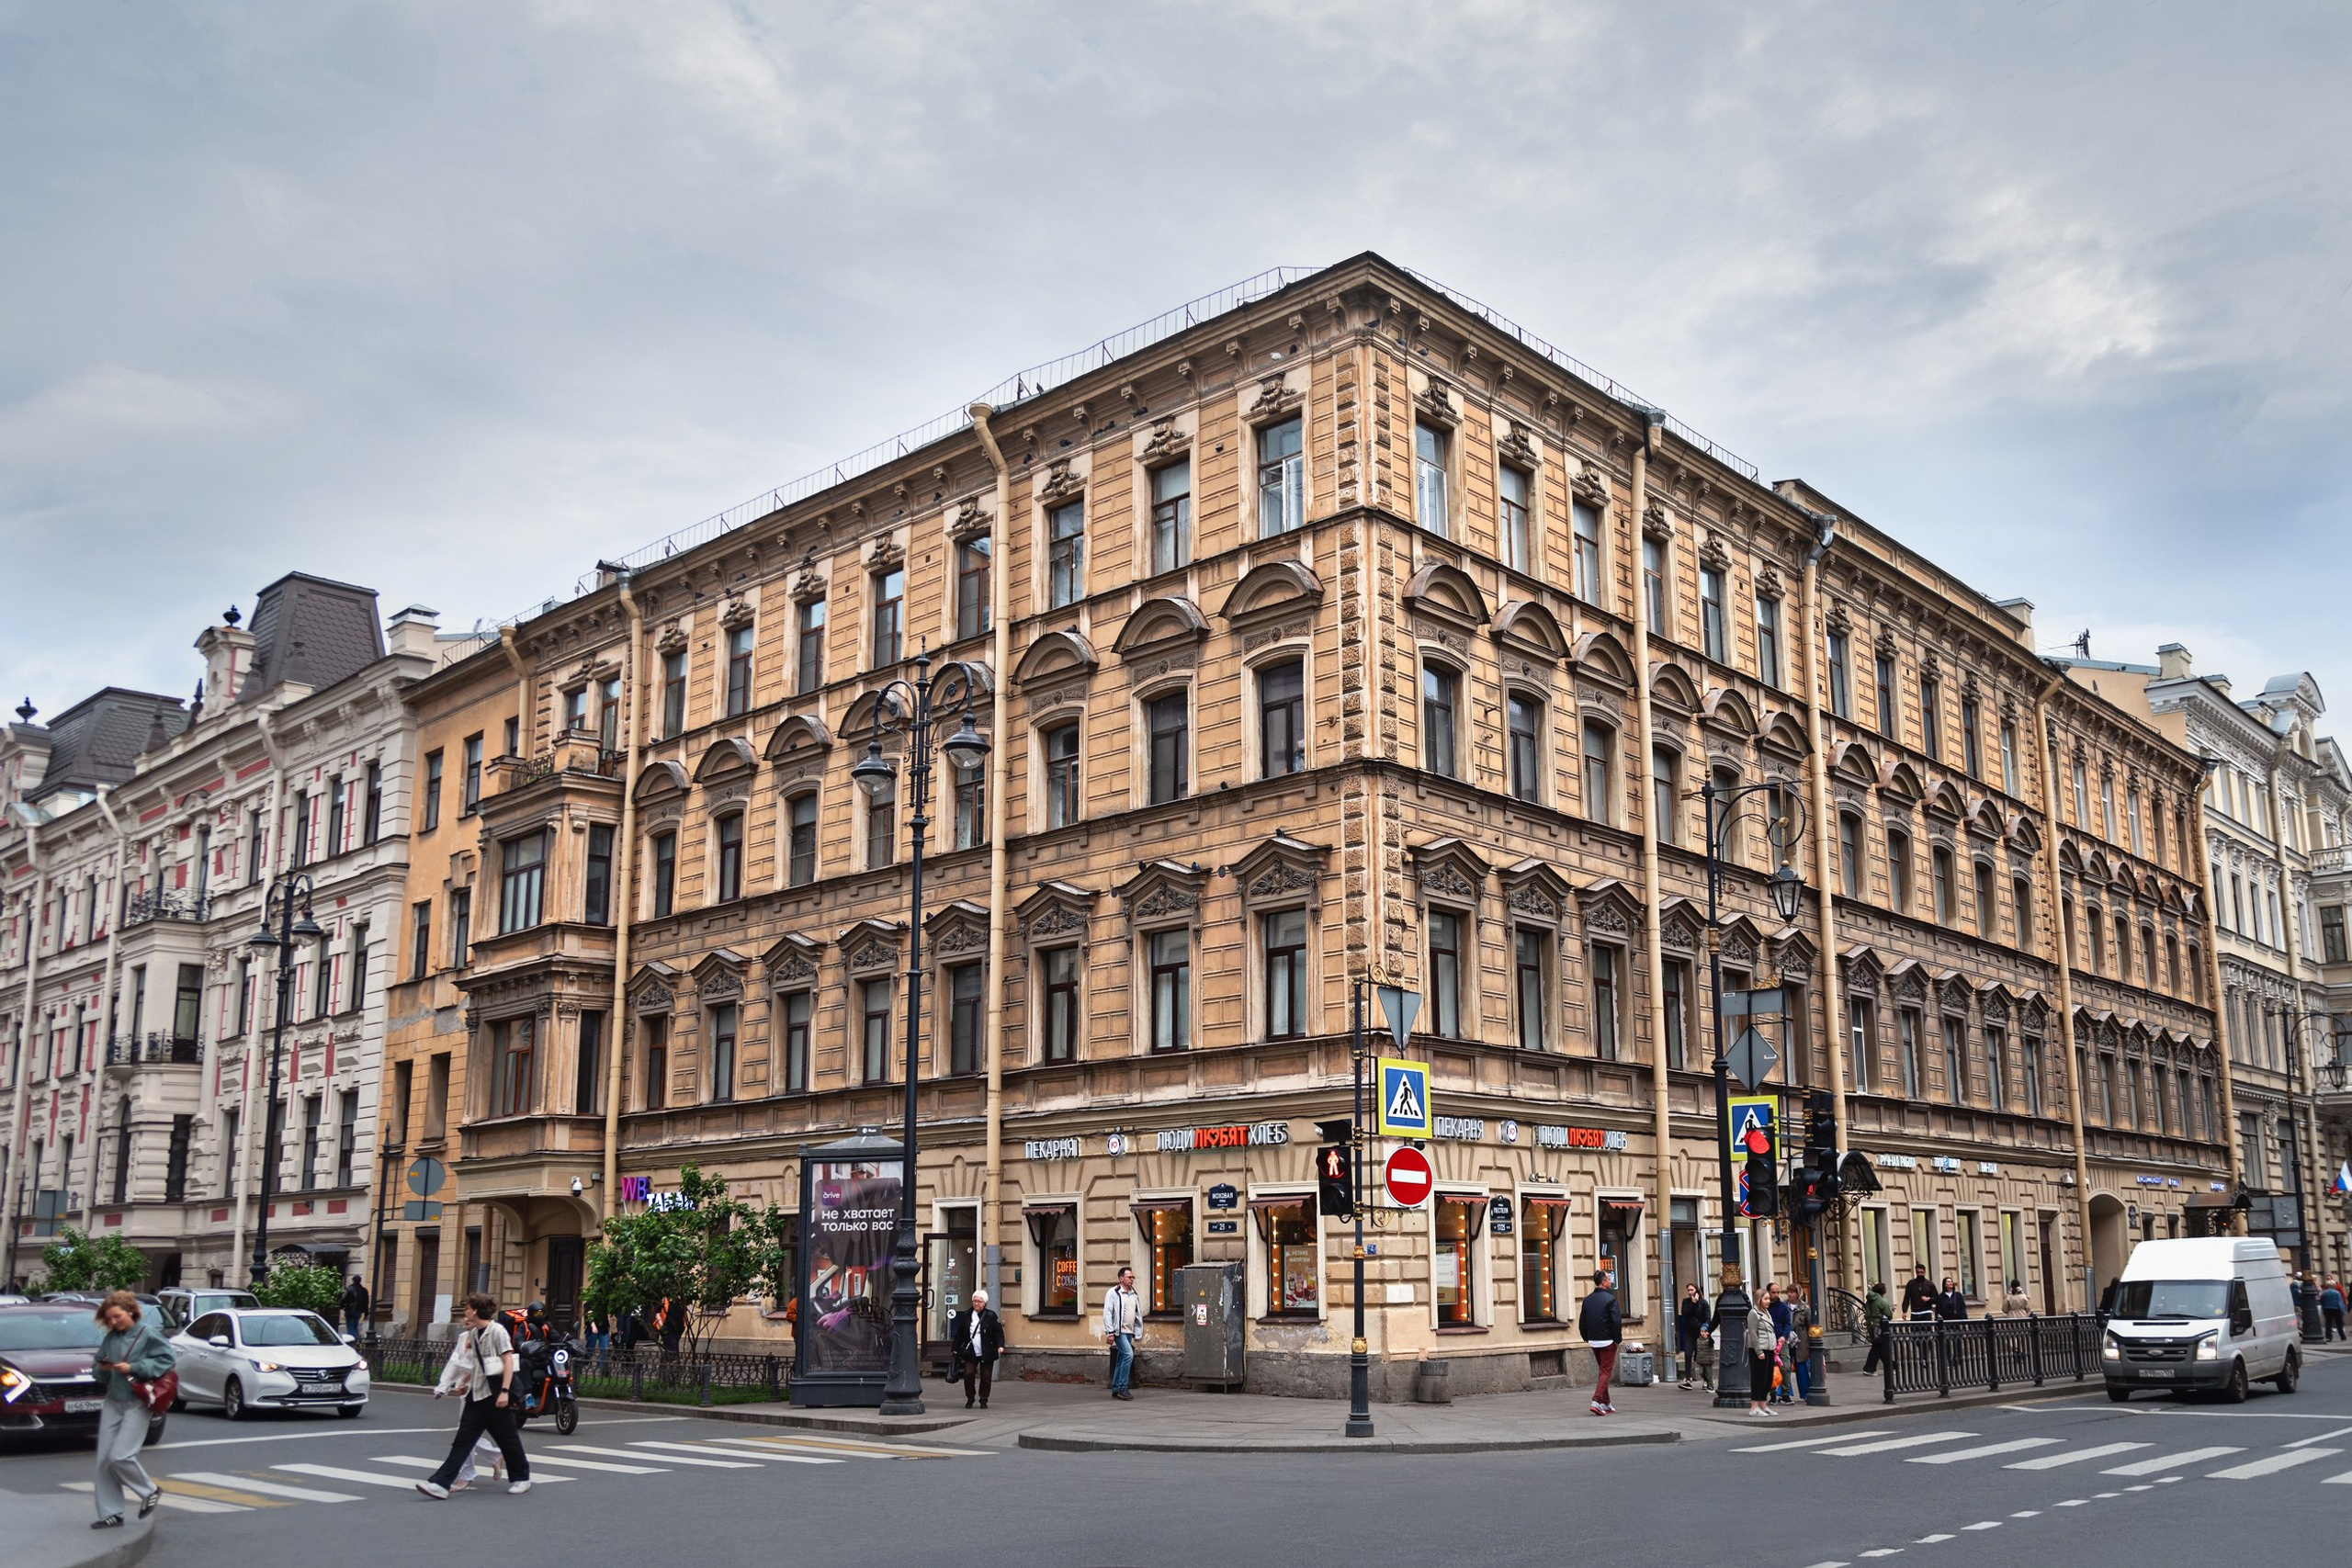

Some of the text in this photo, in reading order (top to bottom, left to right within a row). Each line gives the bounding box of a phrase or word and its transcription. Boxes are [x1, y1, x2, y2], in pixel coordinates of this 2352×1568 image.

[1157, 1122, 1288, 1150] ЛЮДИ ЛЮБЯТ ХЛЕБ
[1437, 1116, 1484, 1140] ПЕКАРНЯ
[1541, 1125, 1628, 1149] ЛЮДИ ЛЮБЯТ ХЛЕБ
[1025, 1138, 1076, 1159] ПЕКАРНЯ
[647, 1191, 695, 1213] ТАБА
[821, 1208, 895, 1220] не хватает
[821, 1221, 894, 1232] только вас
[1219, 1223, 1226, 1231] 25
[1061, 1275, 1077, 1287] СОБО
